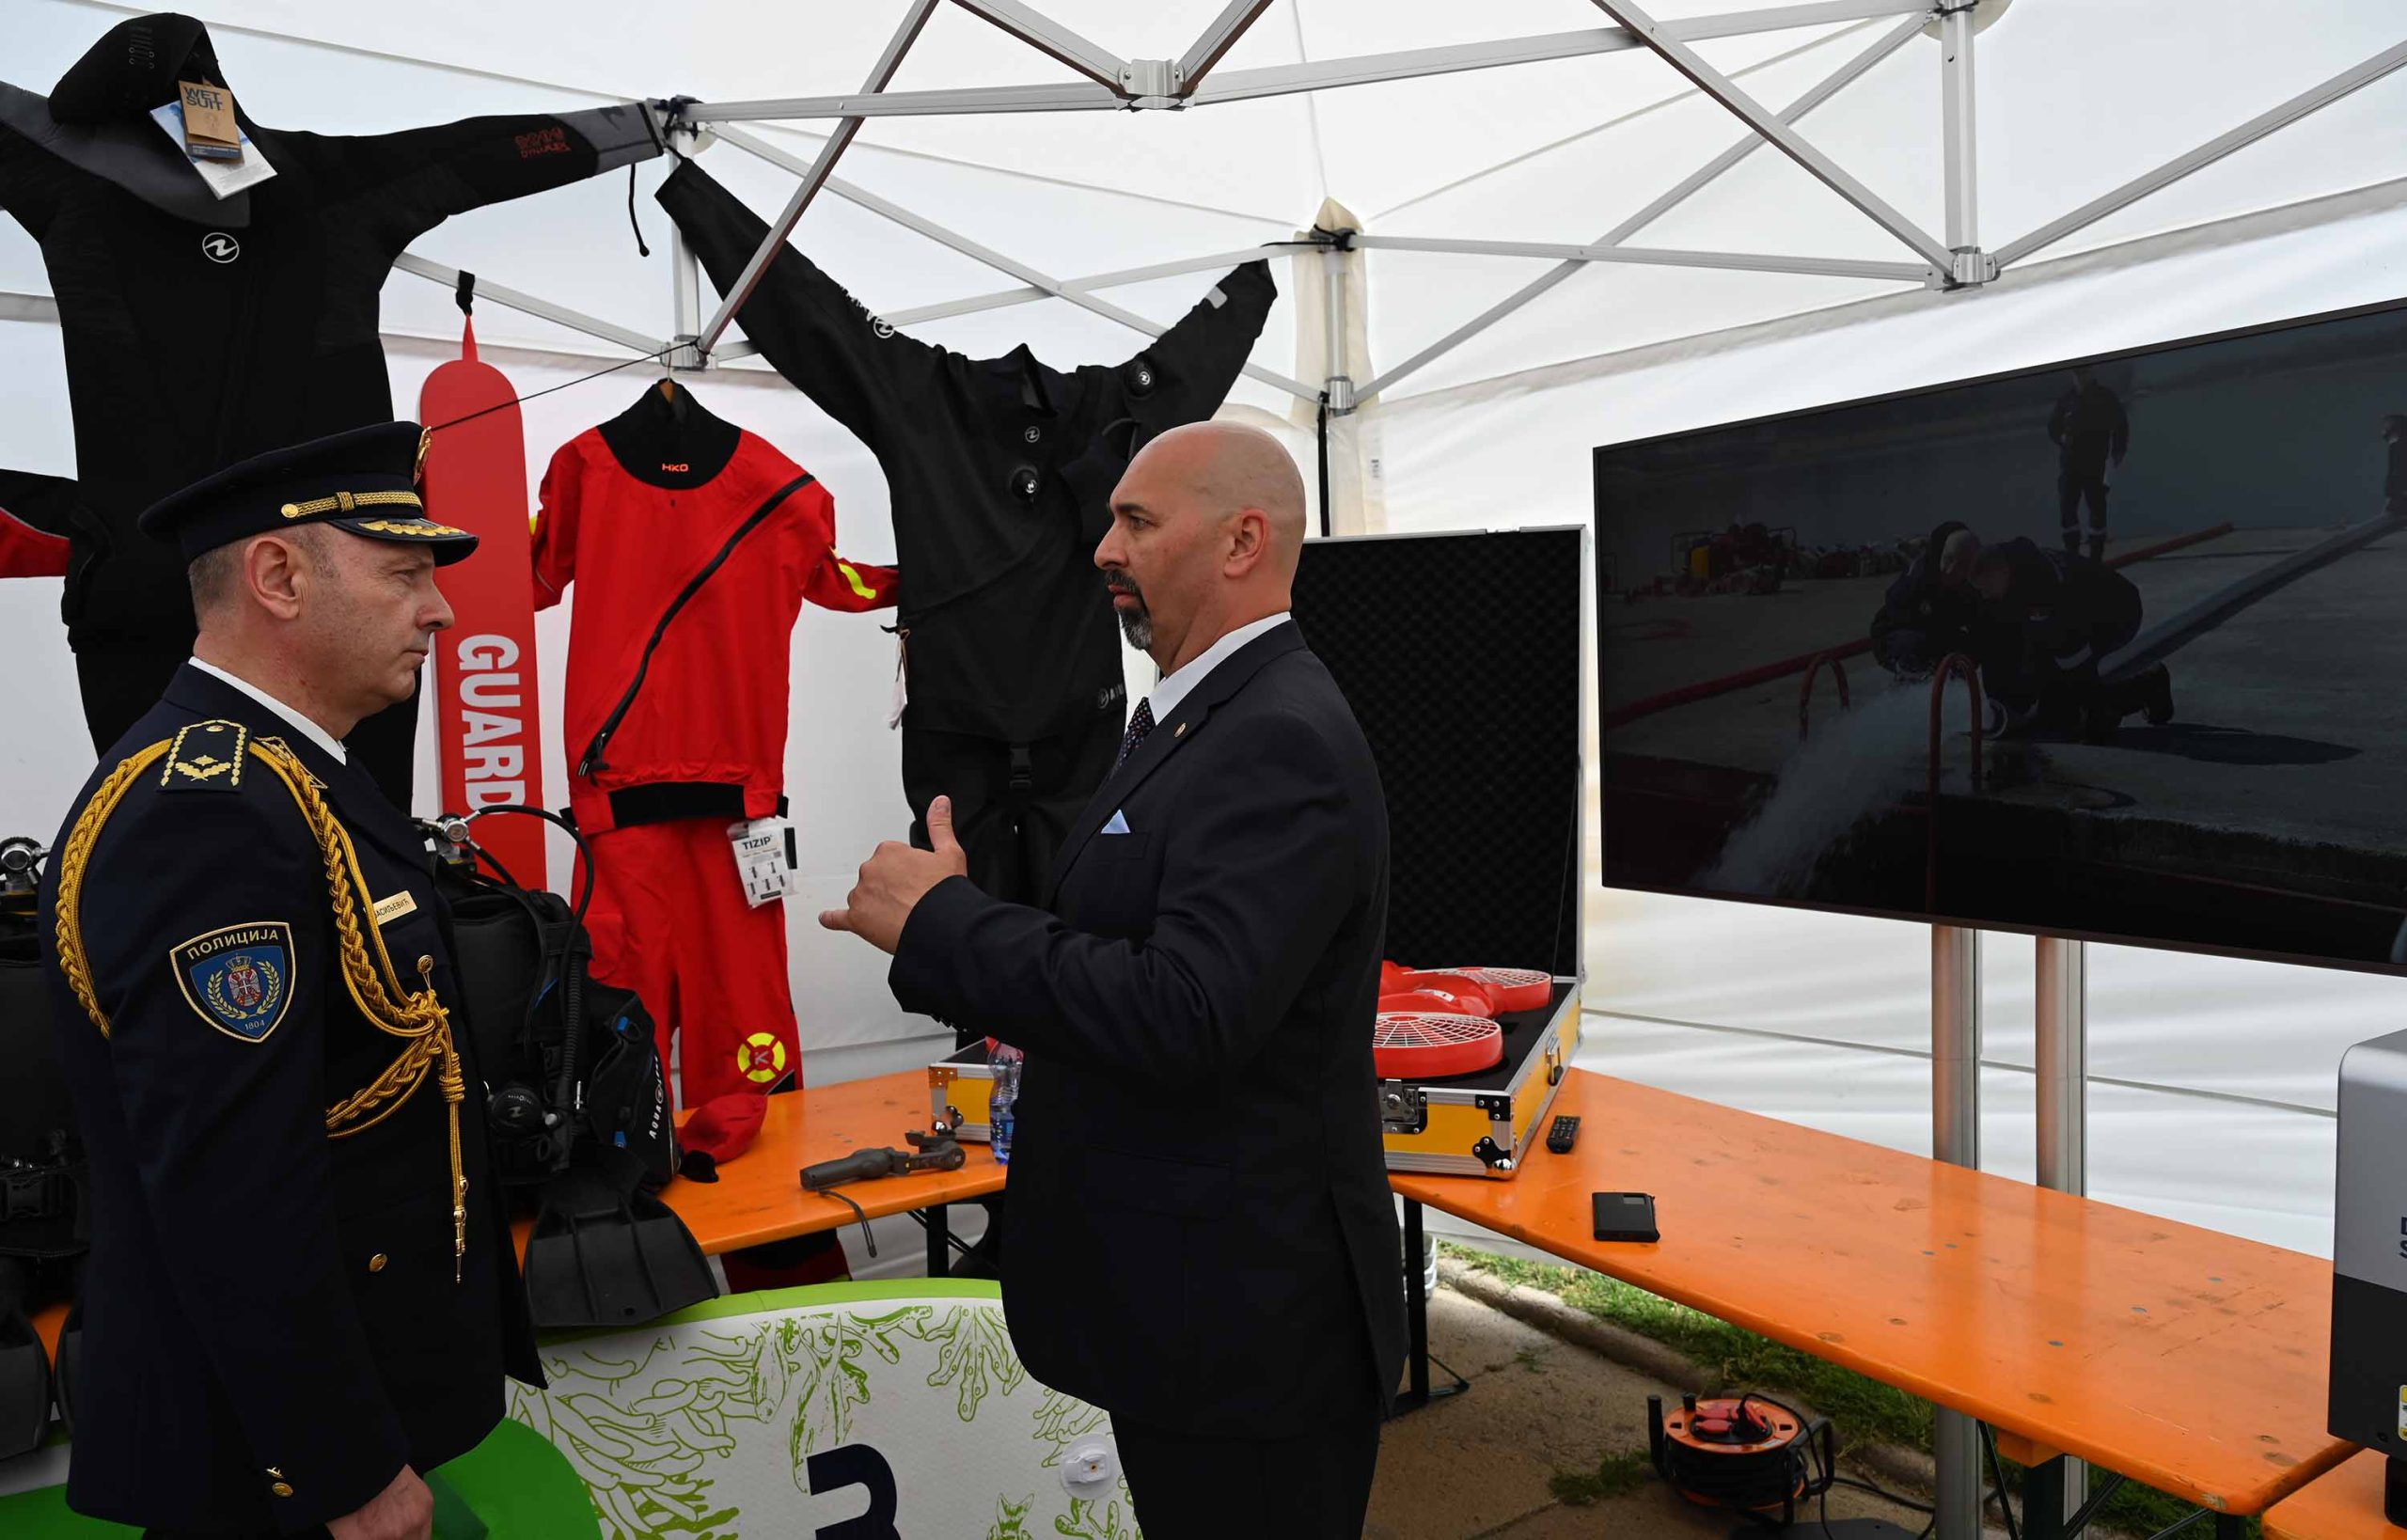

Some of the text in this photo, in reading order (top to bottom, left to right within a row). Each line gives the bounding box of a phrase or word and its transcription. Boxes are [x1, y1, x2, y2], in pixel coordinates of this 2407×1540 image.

[187, 95, 224, 111] SUIT
[457, 634, 527, 815] GUARD
[742, 836, 771, 850] TIZIP
[376, 898, 410, 918] АСИЉЕВИЋ
[186, 928, 279, 960] ПОЛИЦИЈА
[244, 1019, 265, 1030] 1804
[649, 1104, 662, 1139] AQUA
